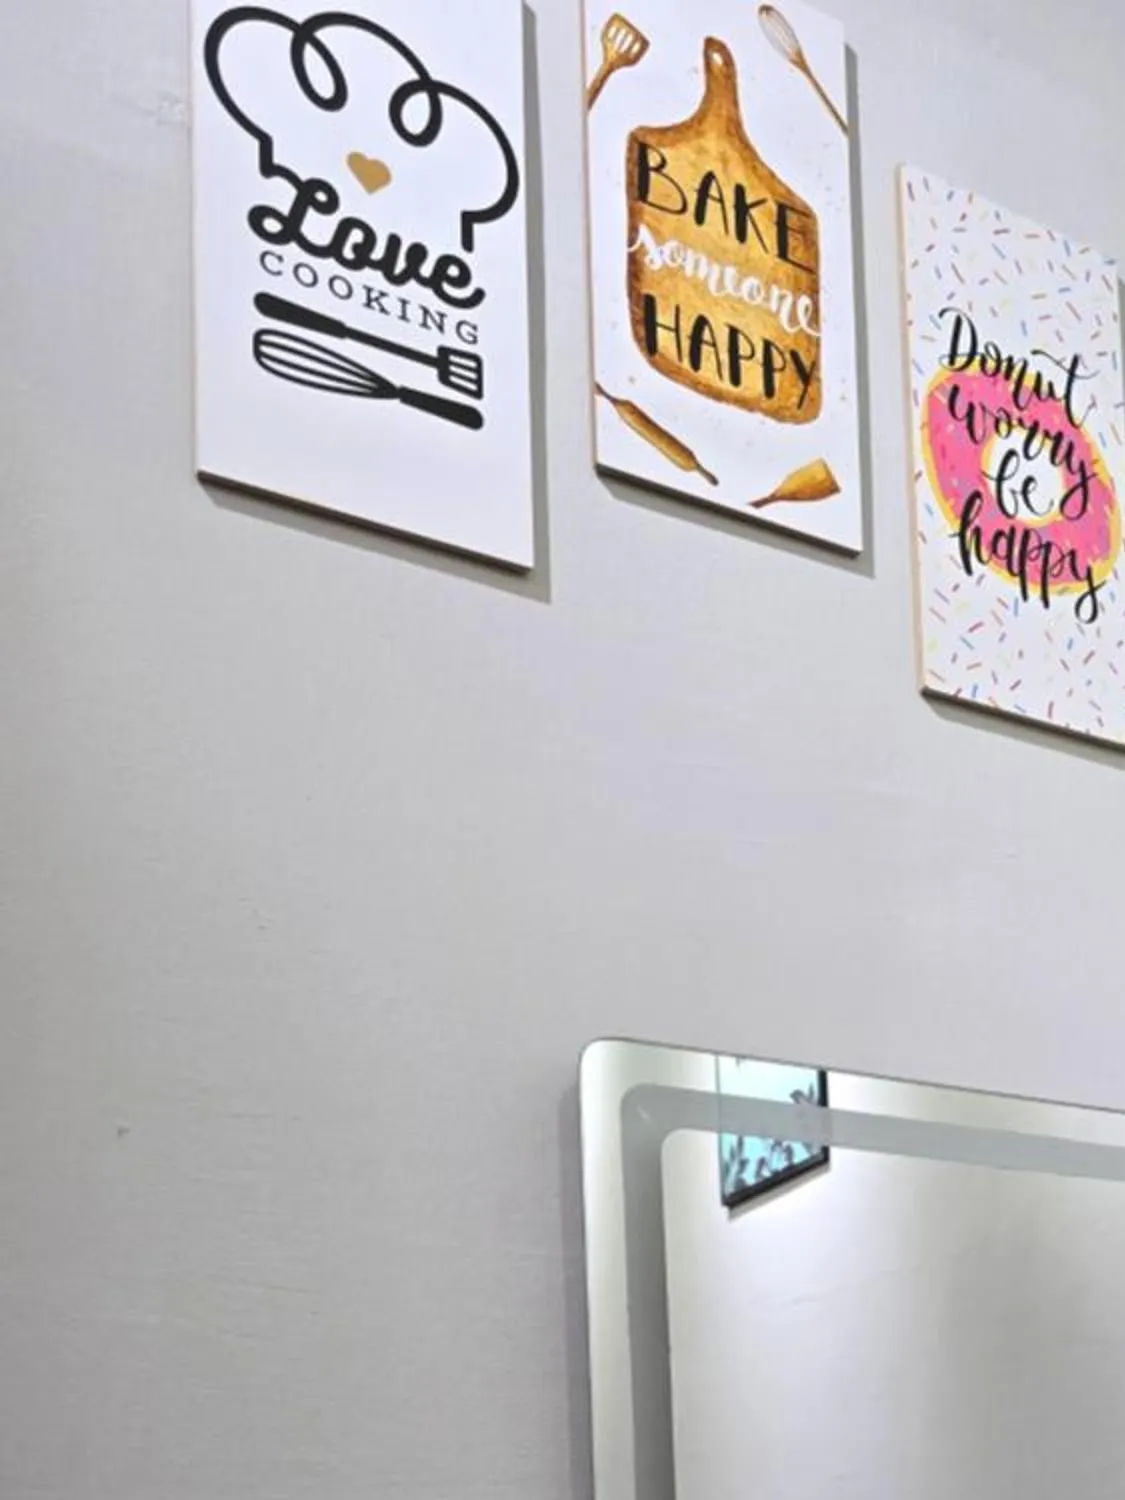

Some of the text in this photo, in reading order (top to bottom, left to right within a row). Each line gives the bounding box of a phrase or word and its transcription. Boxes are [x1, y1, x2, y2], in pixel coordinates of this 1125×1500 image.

[247, 177, 486, 309] Love
[637, 141, 817, 275] BAKE
[259, 250, 479, 345] COOKING
[627, 223, 822, 337] someone
[642, 293, 817, 411] HAPPY
[938, 306, 1100, 428] Donut
[948, 383, 1098, 521] worry
[979, 448, 1054, 519] be
[948, 489, 1106, 624] happy
